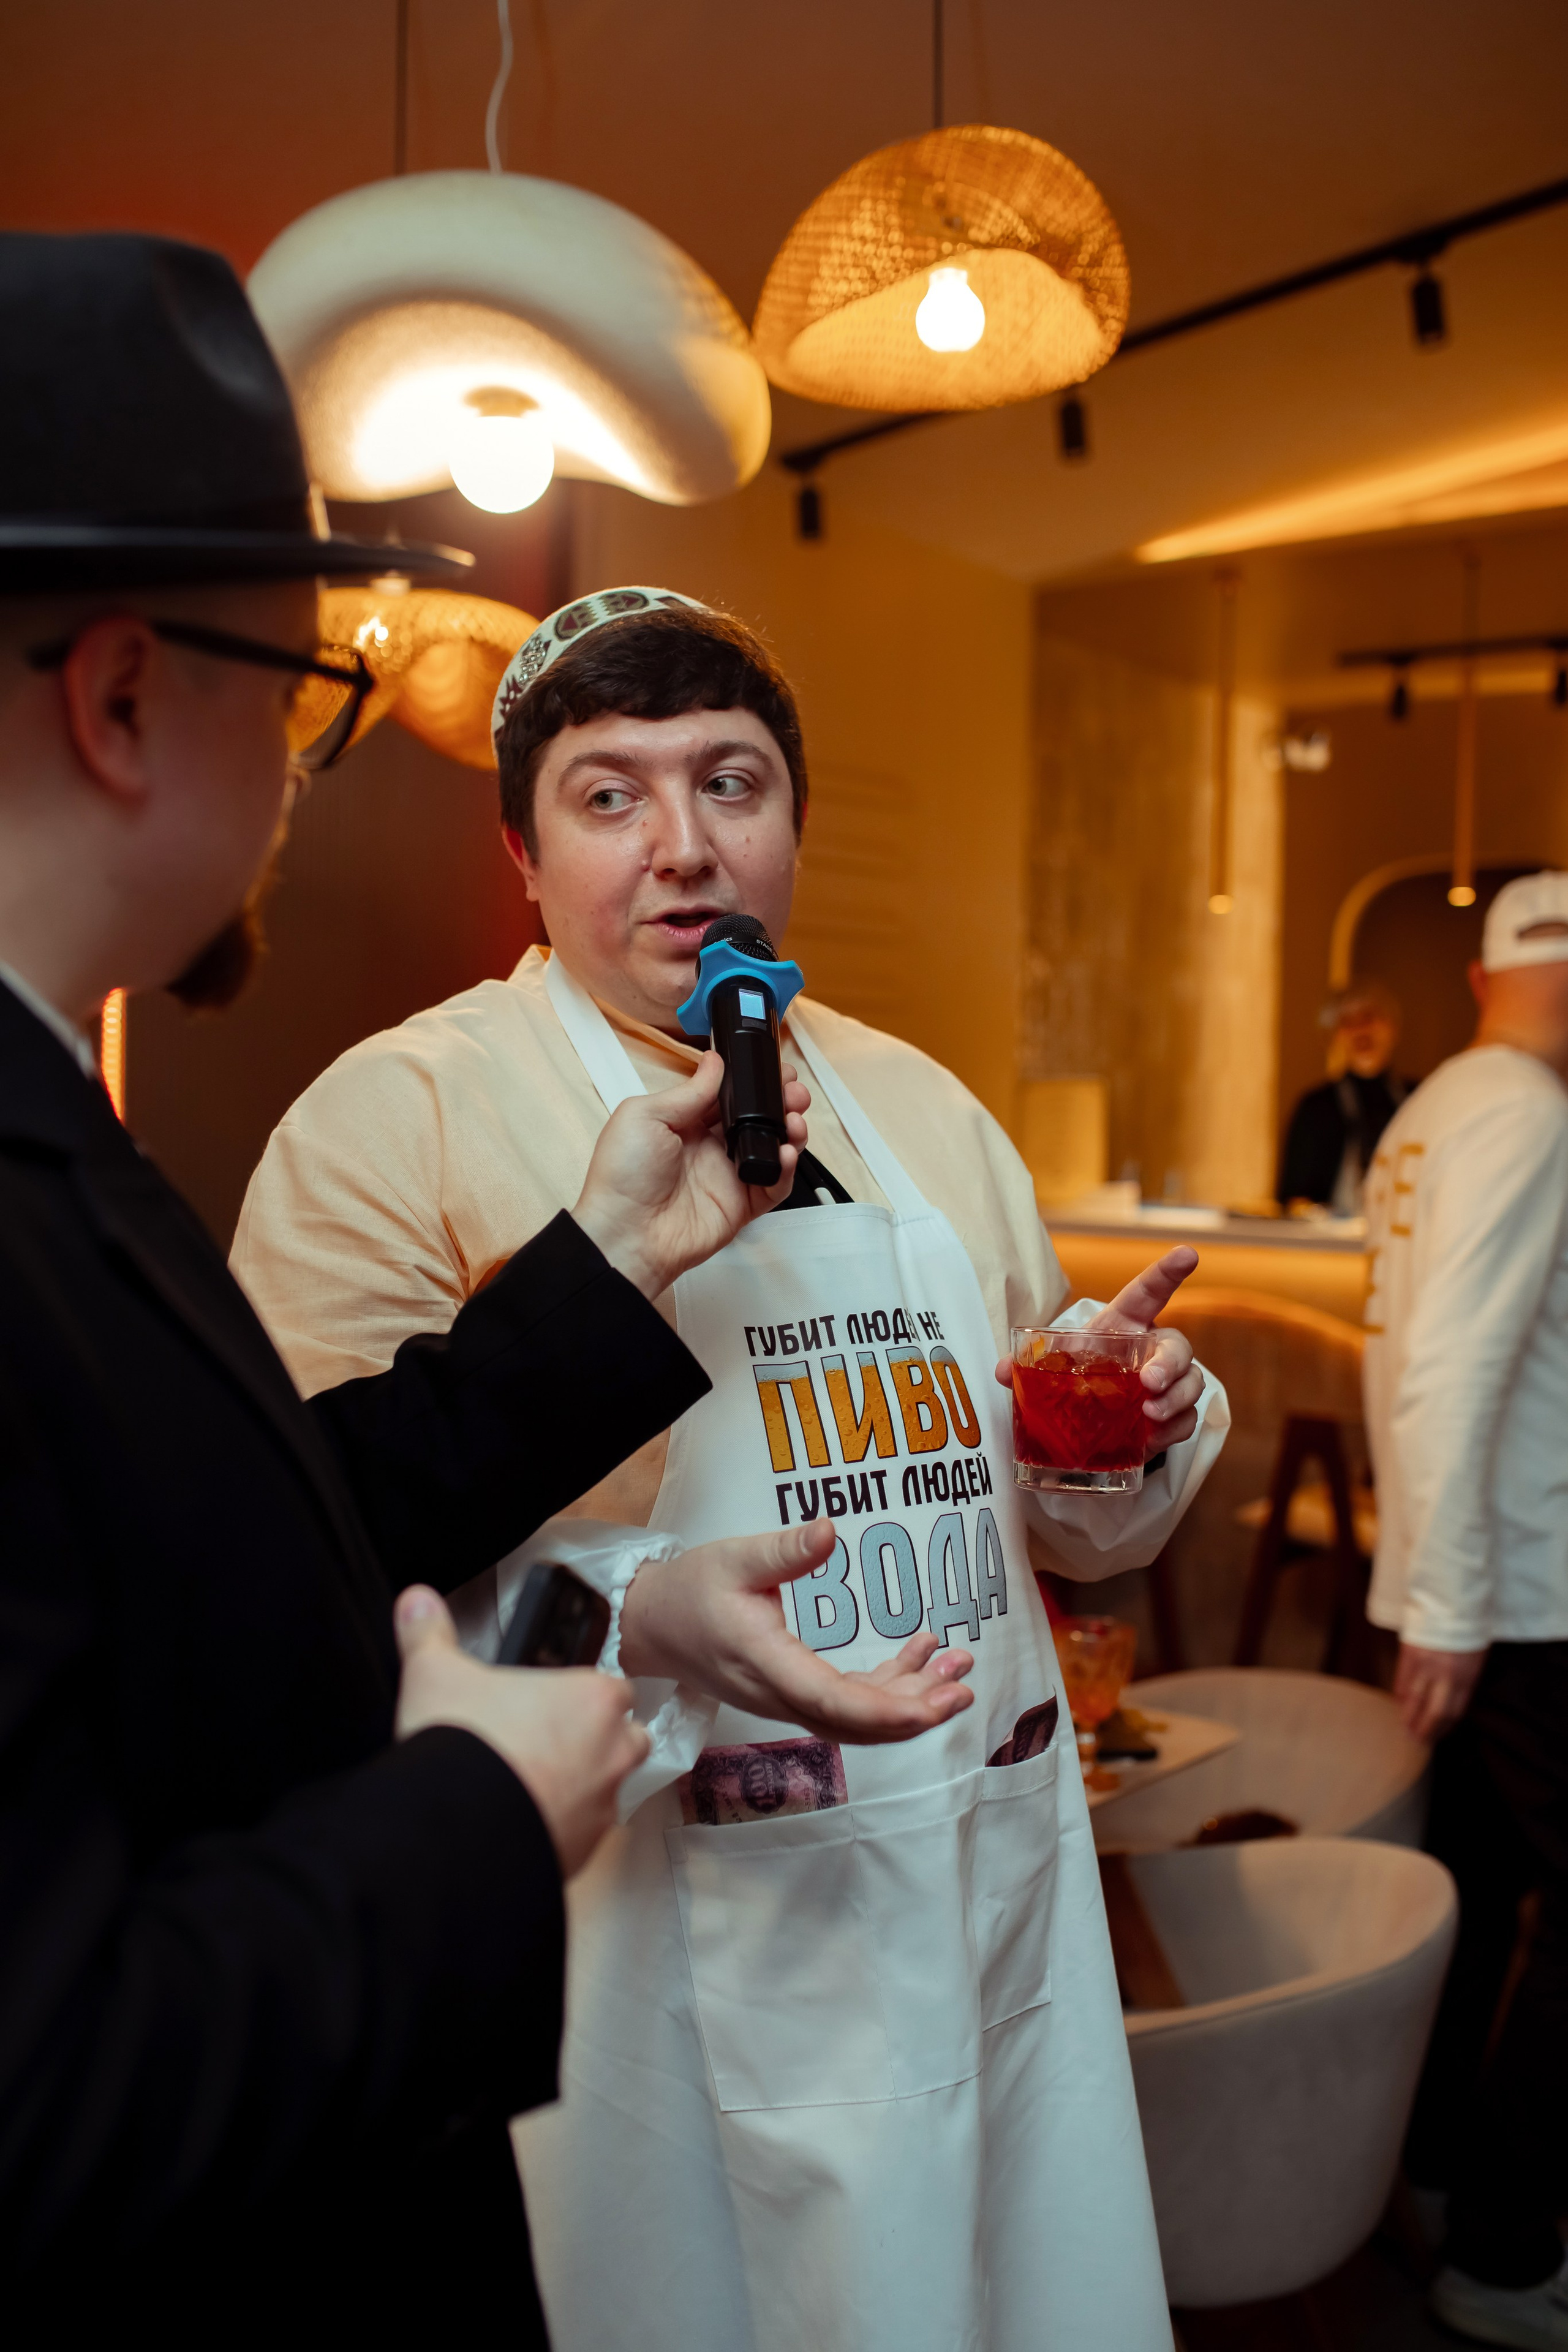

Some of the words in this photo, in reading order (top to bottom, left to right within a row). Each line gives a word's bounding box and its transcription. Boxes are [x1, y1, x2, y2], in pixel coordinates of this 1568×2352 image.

[744, 1314, 837, 1356] ГУБИТ
[916, 1311, 945, 1341] НЕ
[752, 1346, 981, 1473] ПИВО
[775, 1470, 888, 1525] ГУБИТ
[902, 1452, 993, 1507] ЛЮДЕЙ
[791, 1507, 1008, 1651] ВОДА
